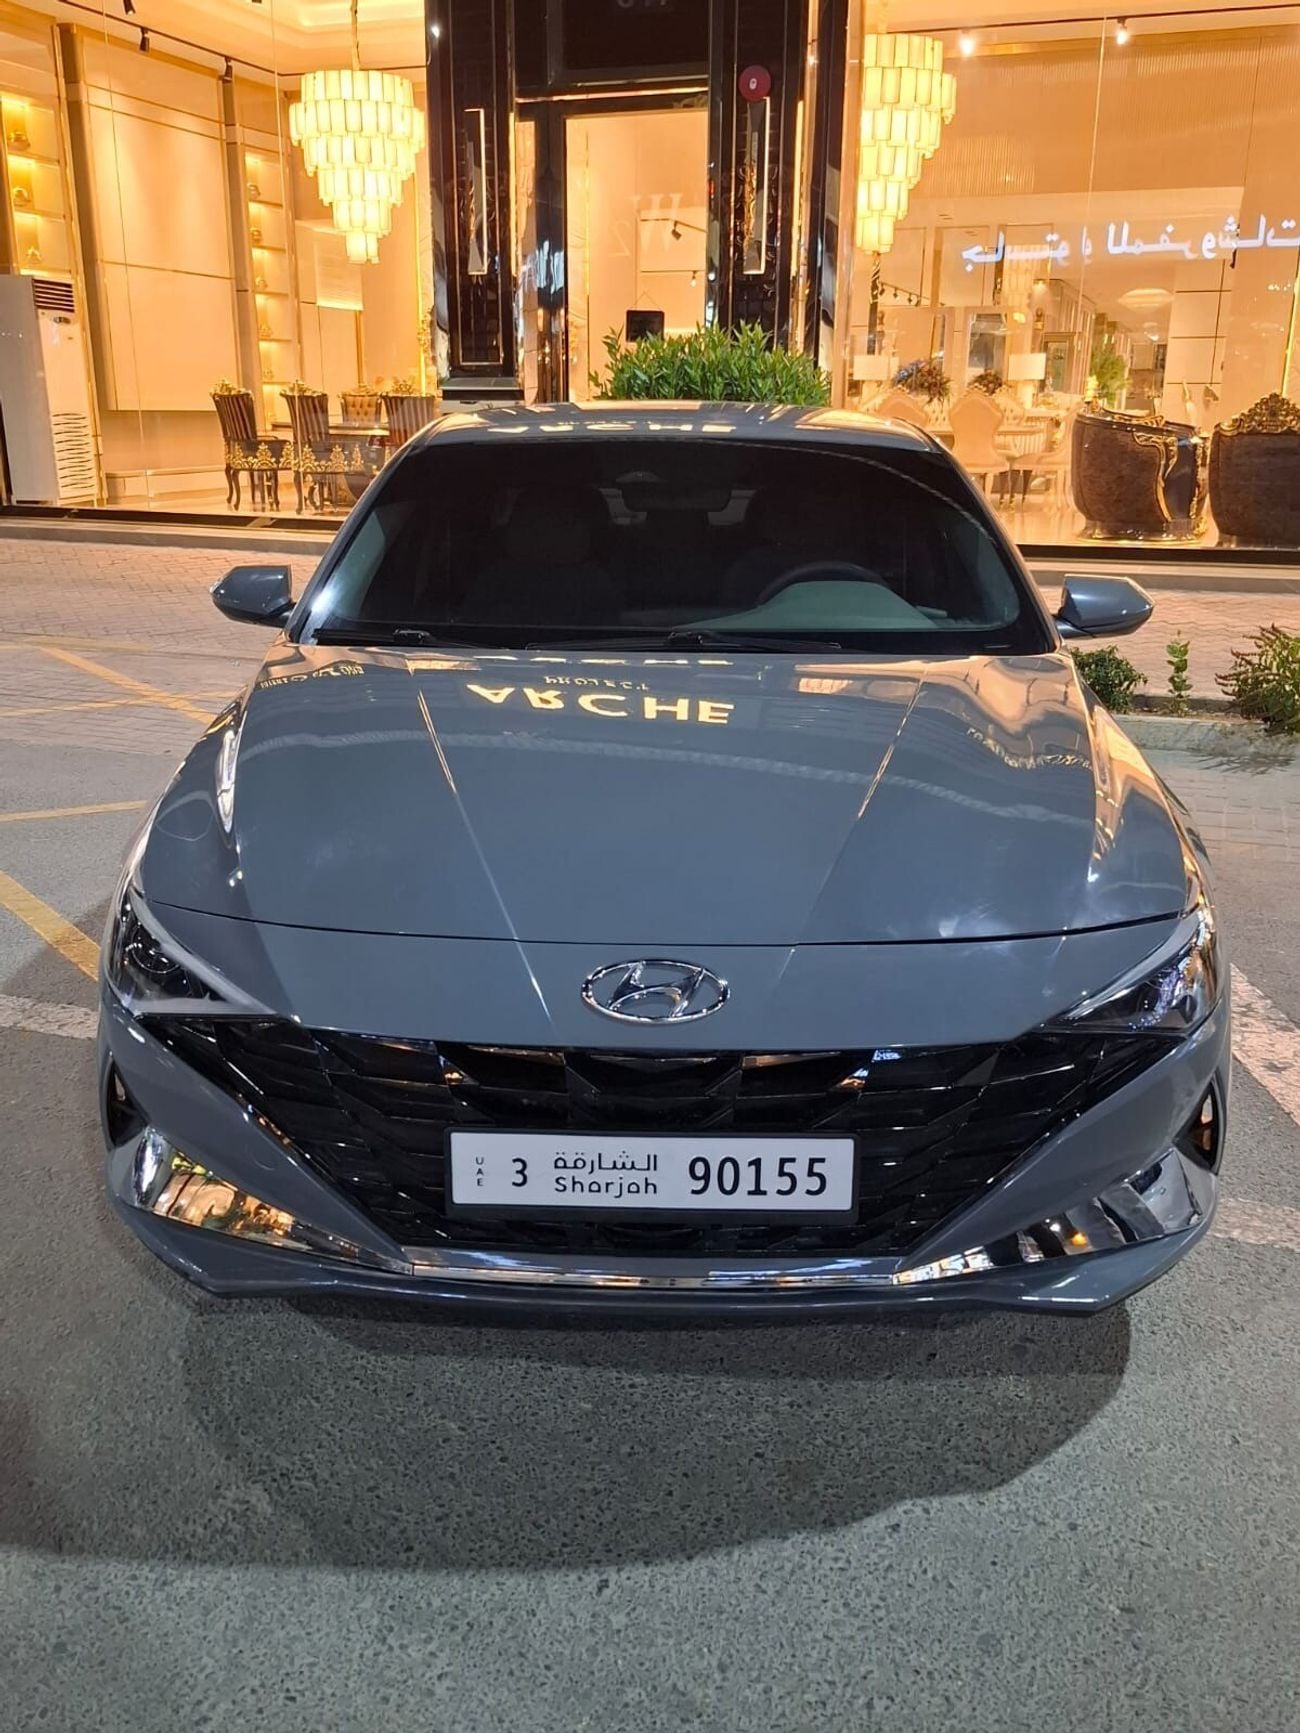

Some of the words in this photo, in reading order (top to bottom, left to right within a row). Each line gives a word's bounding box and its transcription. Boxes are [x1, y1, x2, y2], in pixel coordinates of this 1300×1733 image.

[511, 1158, 529, 1187] 3
[553, 1150, 659, 1175] الشارقة
[554, 1175, 658, 1199] Sharjah
[688, 1156, 829, 1197] 90155
